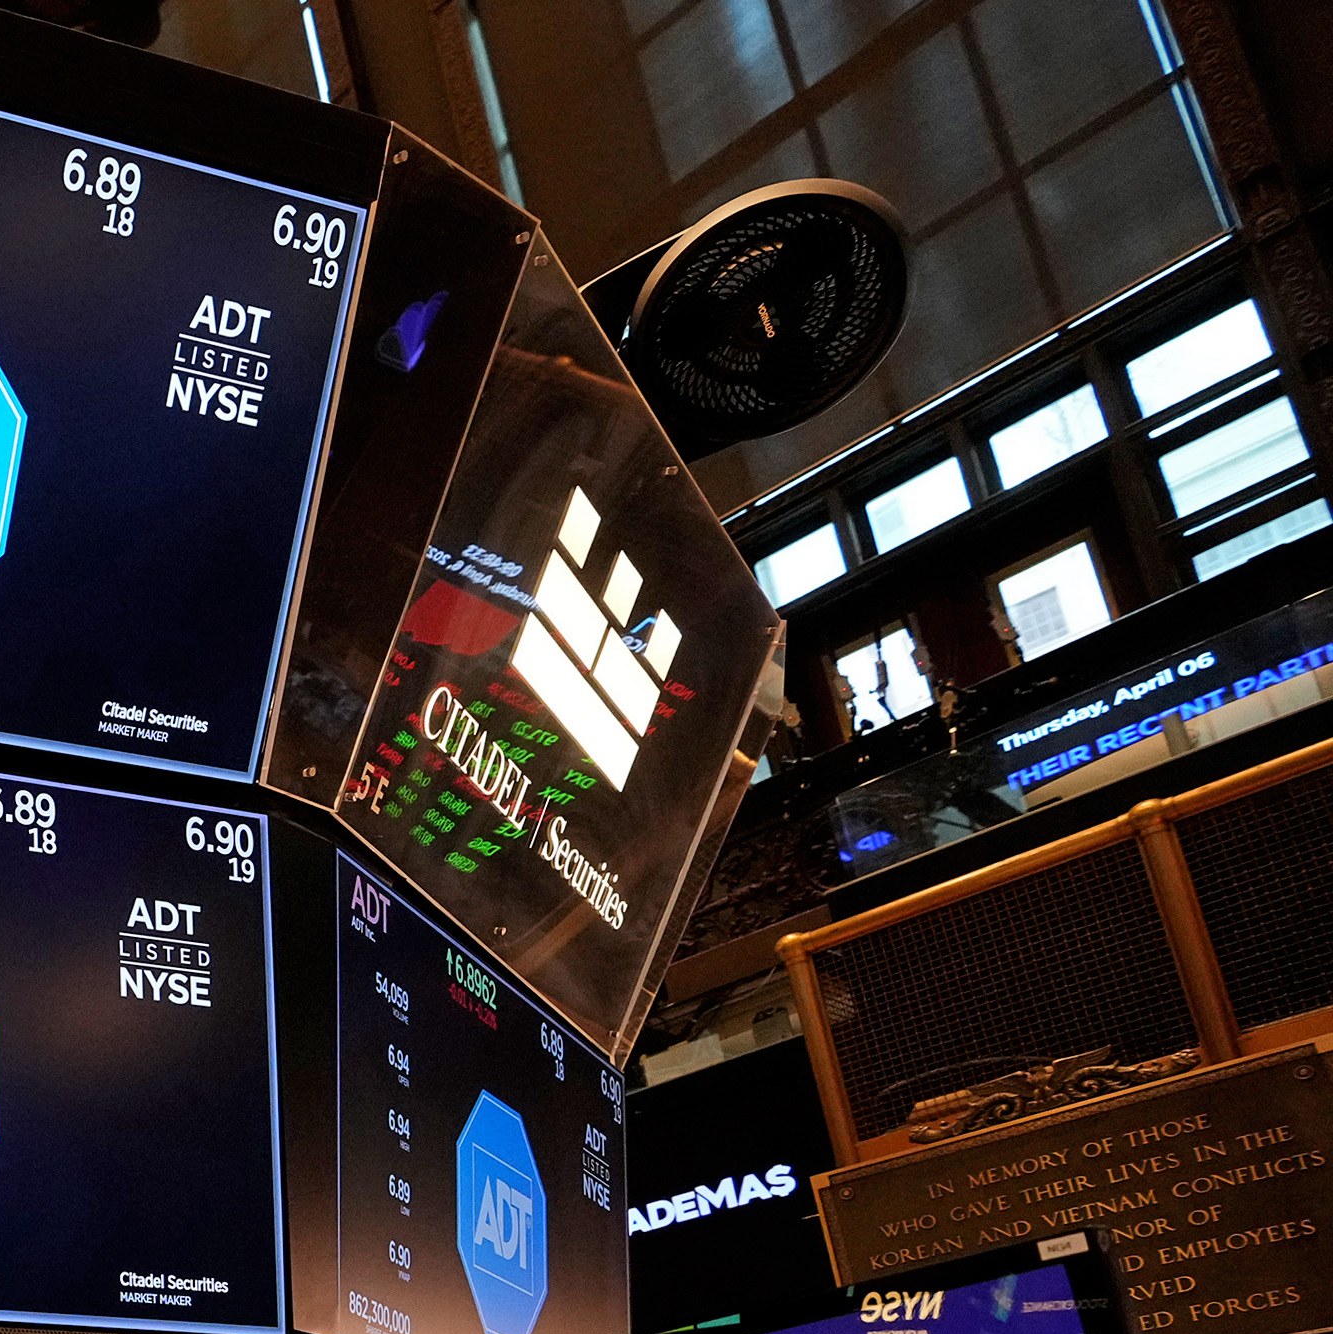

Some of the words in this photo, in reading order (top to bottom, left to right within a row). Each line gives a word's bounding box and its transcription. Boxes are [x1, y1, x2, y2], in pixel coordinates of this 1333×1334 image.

[64, 149, 141, 205] 6.89
[103, 204, 135, 236] 18
[274, 205, 346, 263] 6.90
[309, 257, 339, 288] 19
[188, 295, 271, 347] ADT
[758, 303, 775, 338] VORNADO
[173, 342, 271, 384] LISTED
[166, 372, 264, 426] NYSE
[102, 701, 147, 722] Citadel
[148, 709, 208, 733] Securities
[997, 699, 1109, 752] Thursday,
[1113, 666, 1175, 707] April
[1177, 650, 1217, 677] 06
[98, 721, 136, 737] MARKET
[137, 728, 168, 742] MAKER
[356, 762, 377, 799] 5
[371, 778, 390, 816] E
[1007, 744, 1093, 791] THEIR
[422, 687, 533, 831] CITADEL
[540, 815, 630, 931] Securities
[127, 898, 201, 935] ADT
[119, 940, 210, 969] LISTED
[120, 967, 211, 1007] NYSE
[453, 952, 499, 1011] 6.8962
[926, 1180, 954, 1198] IN
[967, 1149, 1068, 1187] MEMORY
[1082, 1137, 1112, 1157] OF
[1122, 1114, 1211, 1147] THOSE
[584, 1175, 610, 1211] NYSE
[879, 1215, 936, 1237] WHO
[950, 1195, 1011, 1221] GAVE
[1023, 1176, 1095, 1203] THEIR
[1108, 1153, 1180, 1183] LIVES
[1193, 1141, 1226, 1162] IN
[1235, 1125, 1294, 1150] THE
[869, 1236, 963, 1270] KOREAN
[978, 1221, 1032, 1245] AND
[1041, 1188, 1158, 1228] VIETNAM
[1171, 1149, 1325, 1197] CONFLICTS
[120, 1272, 165, 1289] Citadel
[168, 1275, 229, 1293] Securities
